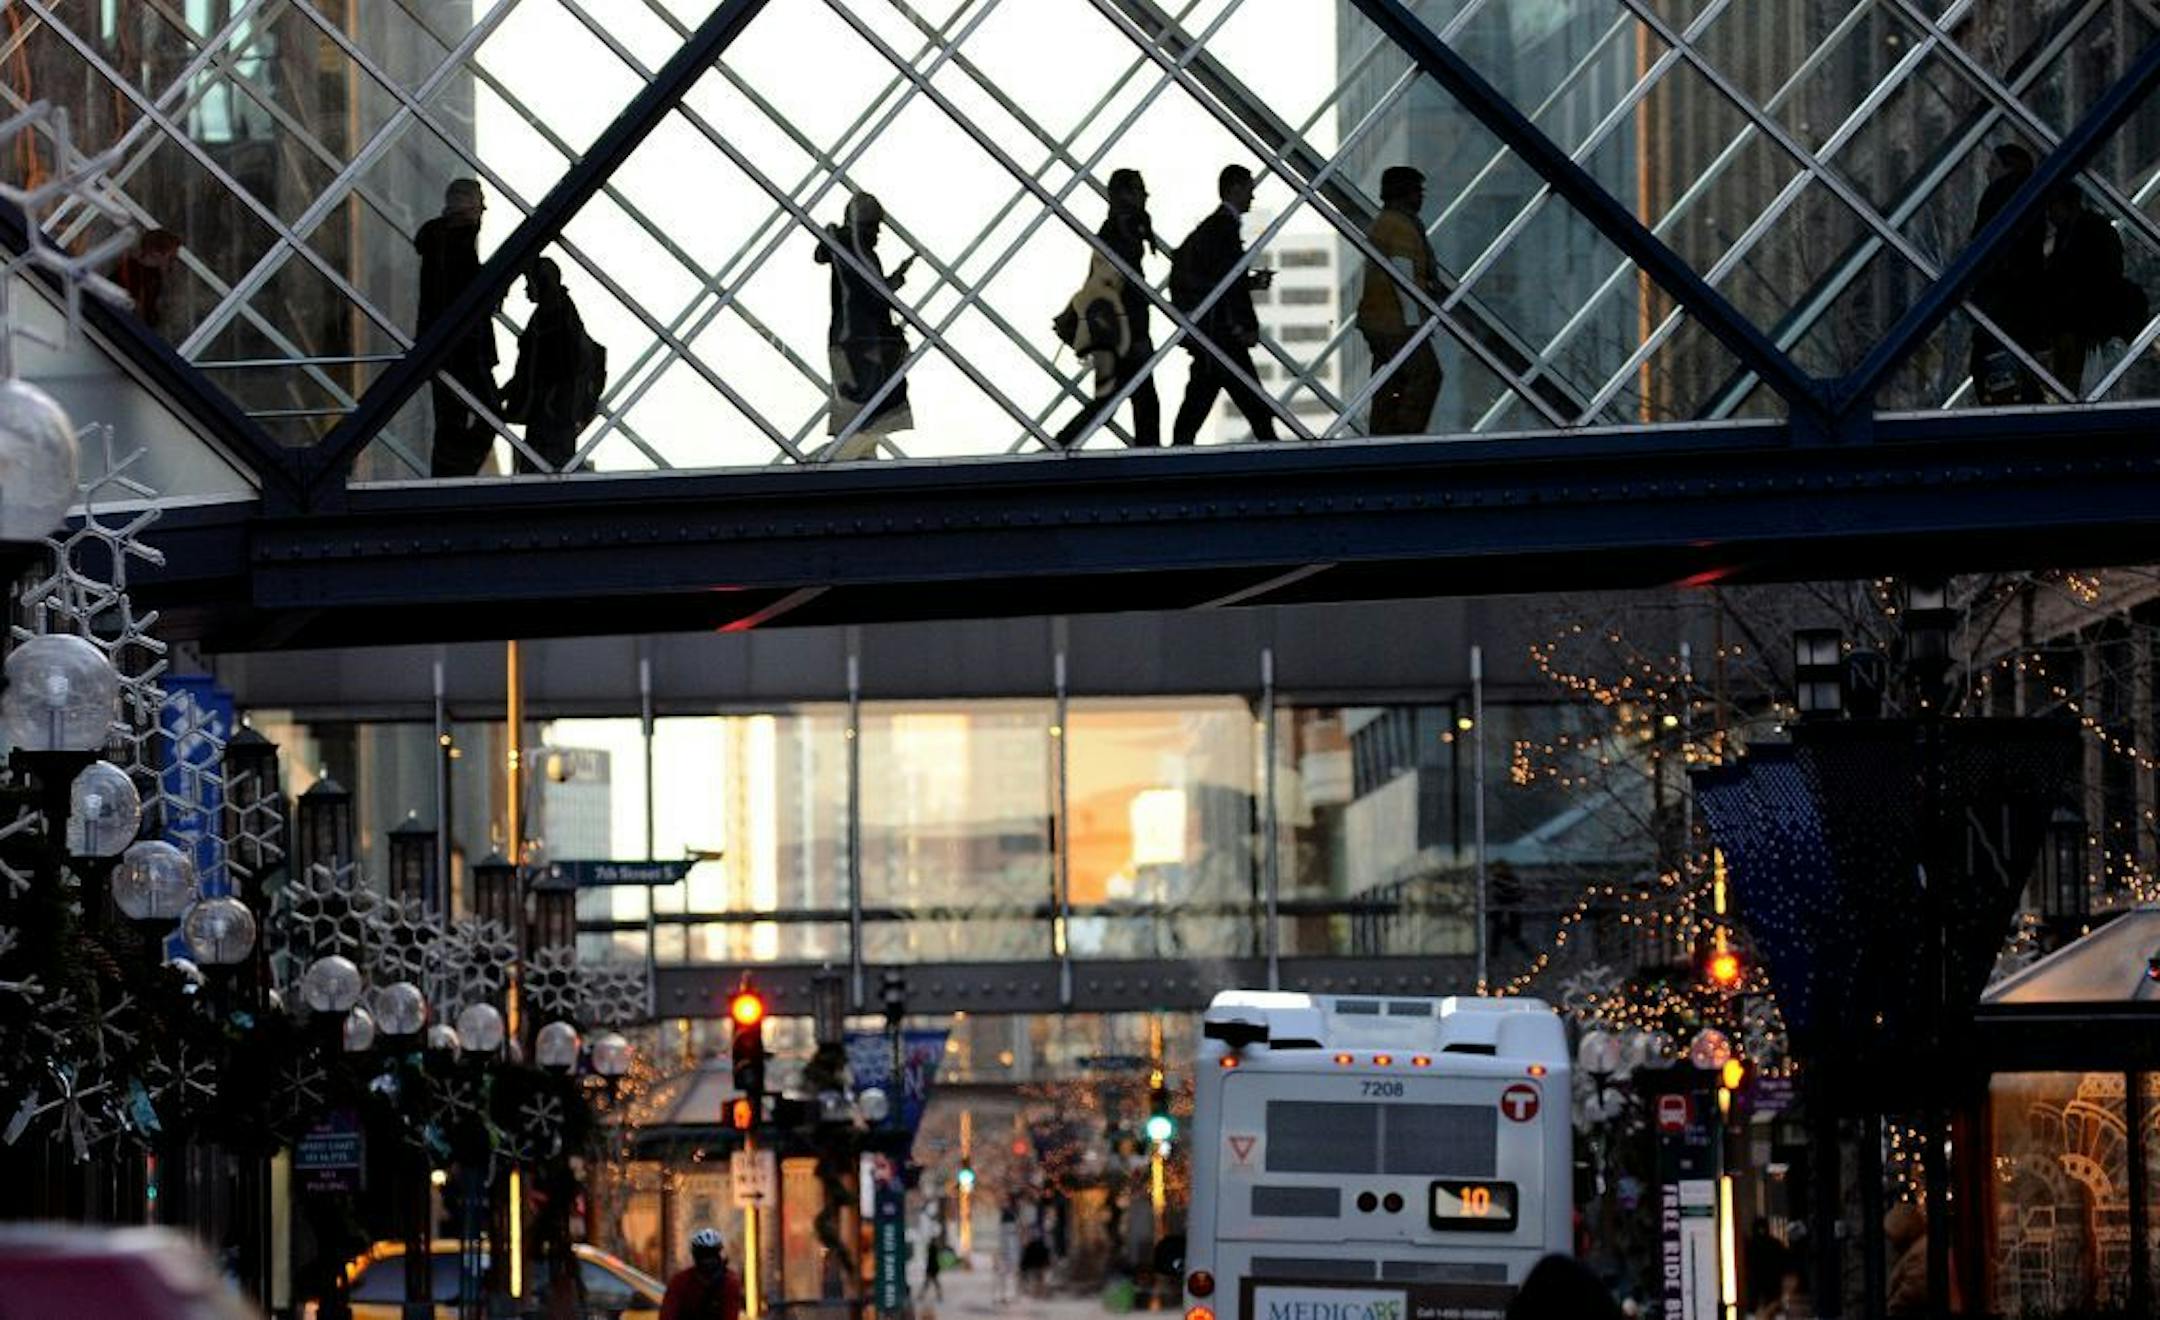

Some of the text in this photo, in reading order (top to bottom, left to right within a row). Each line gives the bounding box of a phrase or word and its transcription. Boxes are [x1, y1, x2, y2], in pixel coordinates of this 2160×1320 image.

[619, 865, 661, 880] Street
[1361, 1081, 1404, 1097] 7208
[1505, 1091, 1537, 1119] T
[1459, 1186, 1491, 1216] 10
[1662, 1184, 1680, 1232] FREE
[1663, 1241, 1681, 1290] RIDE
